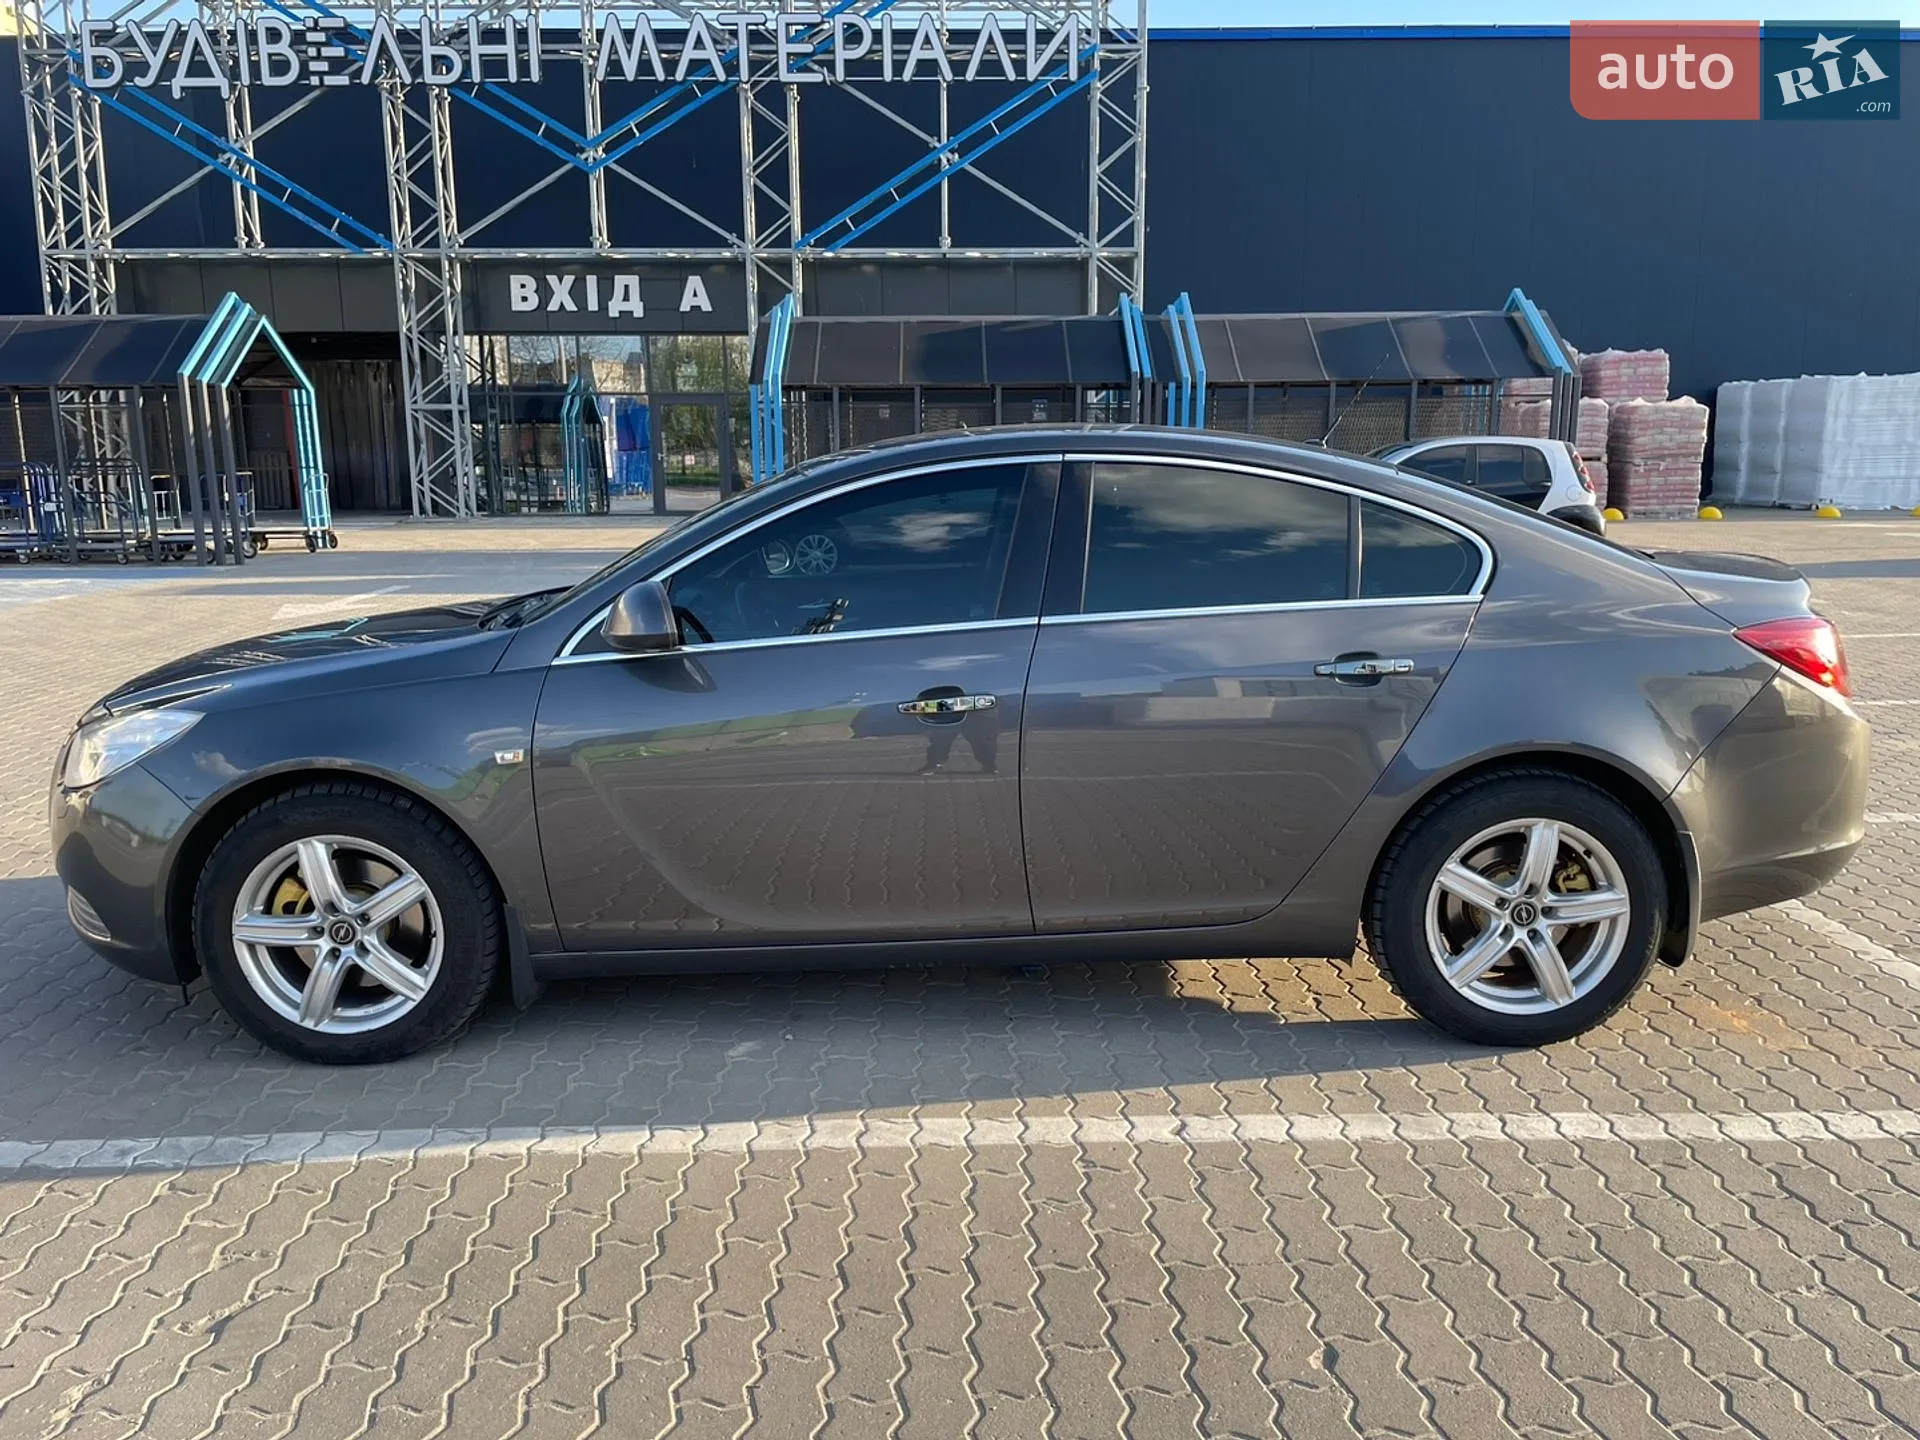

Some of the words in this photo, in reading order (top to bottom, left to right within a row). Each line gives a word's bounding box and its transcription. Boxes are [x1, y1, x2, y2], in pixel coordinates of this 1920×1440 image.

[80, 15, 541, 99] БУДІВЕЛЬНІ
[596, 12, 1080, 83] МАТЕРІАЛИ
[509, 274, 644, 319] ВХІД
[679, 275, 713, 313] А
